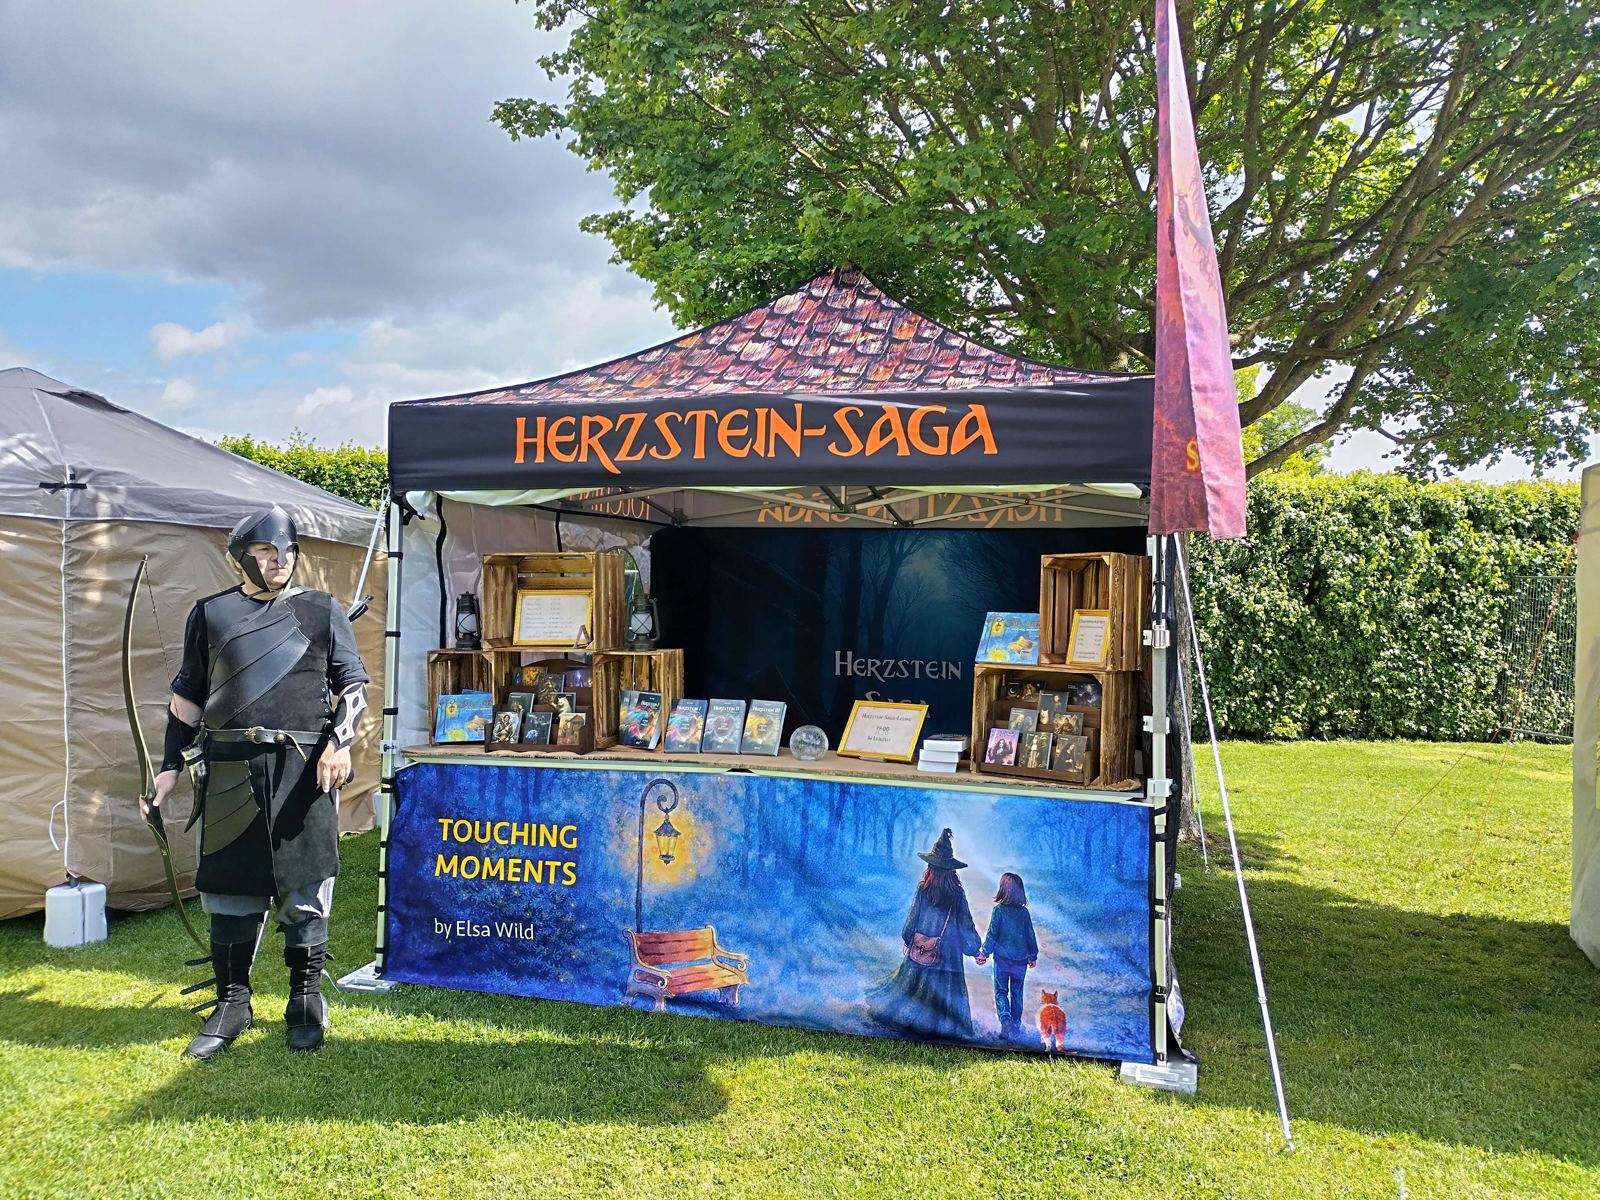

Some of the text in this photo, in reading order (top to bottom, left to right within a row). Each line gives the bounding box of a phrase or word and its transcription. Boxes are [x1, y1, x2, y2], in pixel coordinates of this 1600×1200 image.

[438, 818, 578, 849] TOUCHING
[434, 854, 577, 886] MOMENTS
[434, 918, 534, 940] by Elsa Wild
